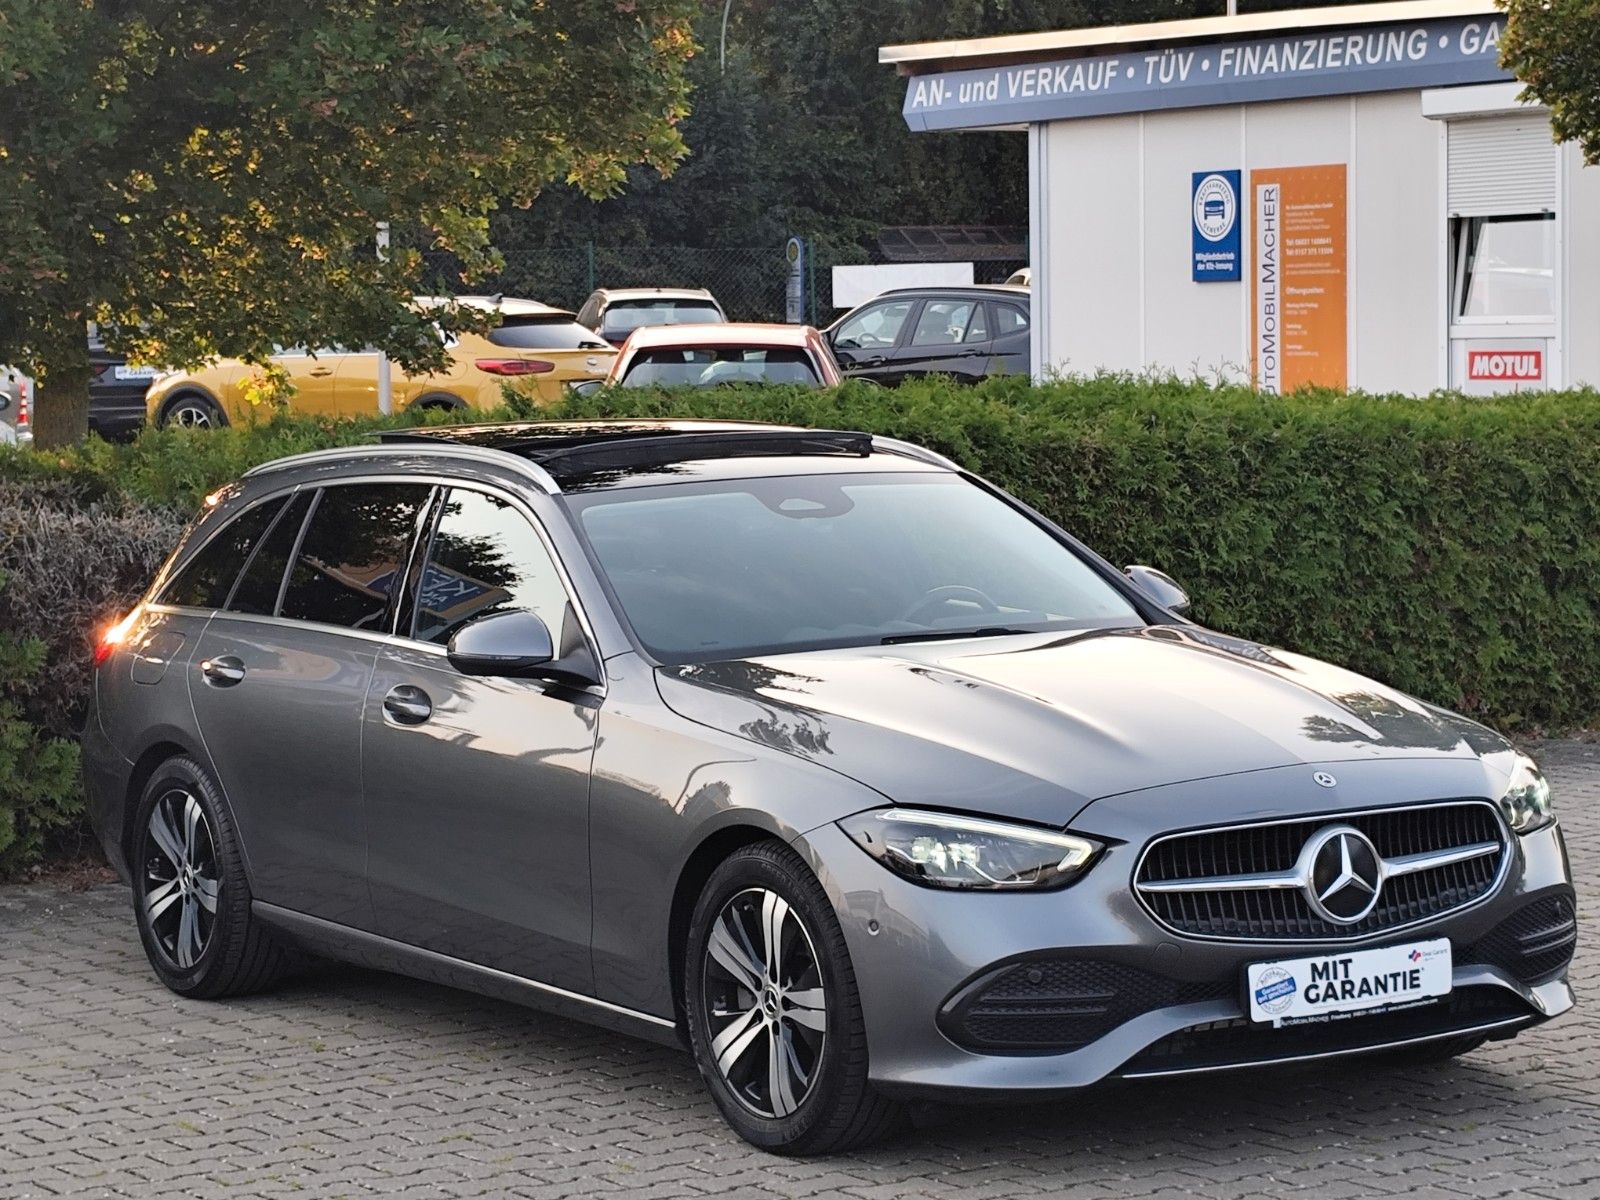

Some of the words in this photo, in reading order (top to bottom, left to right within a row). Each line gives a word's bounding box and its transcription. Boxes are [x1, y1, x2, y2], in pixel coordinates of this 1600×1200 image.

[912, 79, 951, 108] AN-
[958, 73, 999, 104] und
[1007, 60, 1119, 98] VERKAUF
[1144, 49, 1194, 85] TÜV
[1217, 28, 1427, 78] FINANZIERUNG
[1472, 355, 1539, 377] MOTUL
[1311, 959, 1353, 982] MIT
[1304, 968, 1422, 1004] GARANTIE
